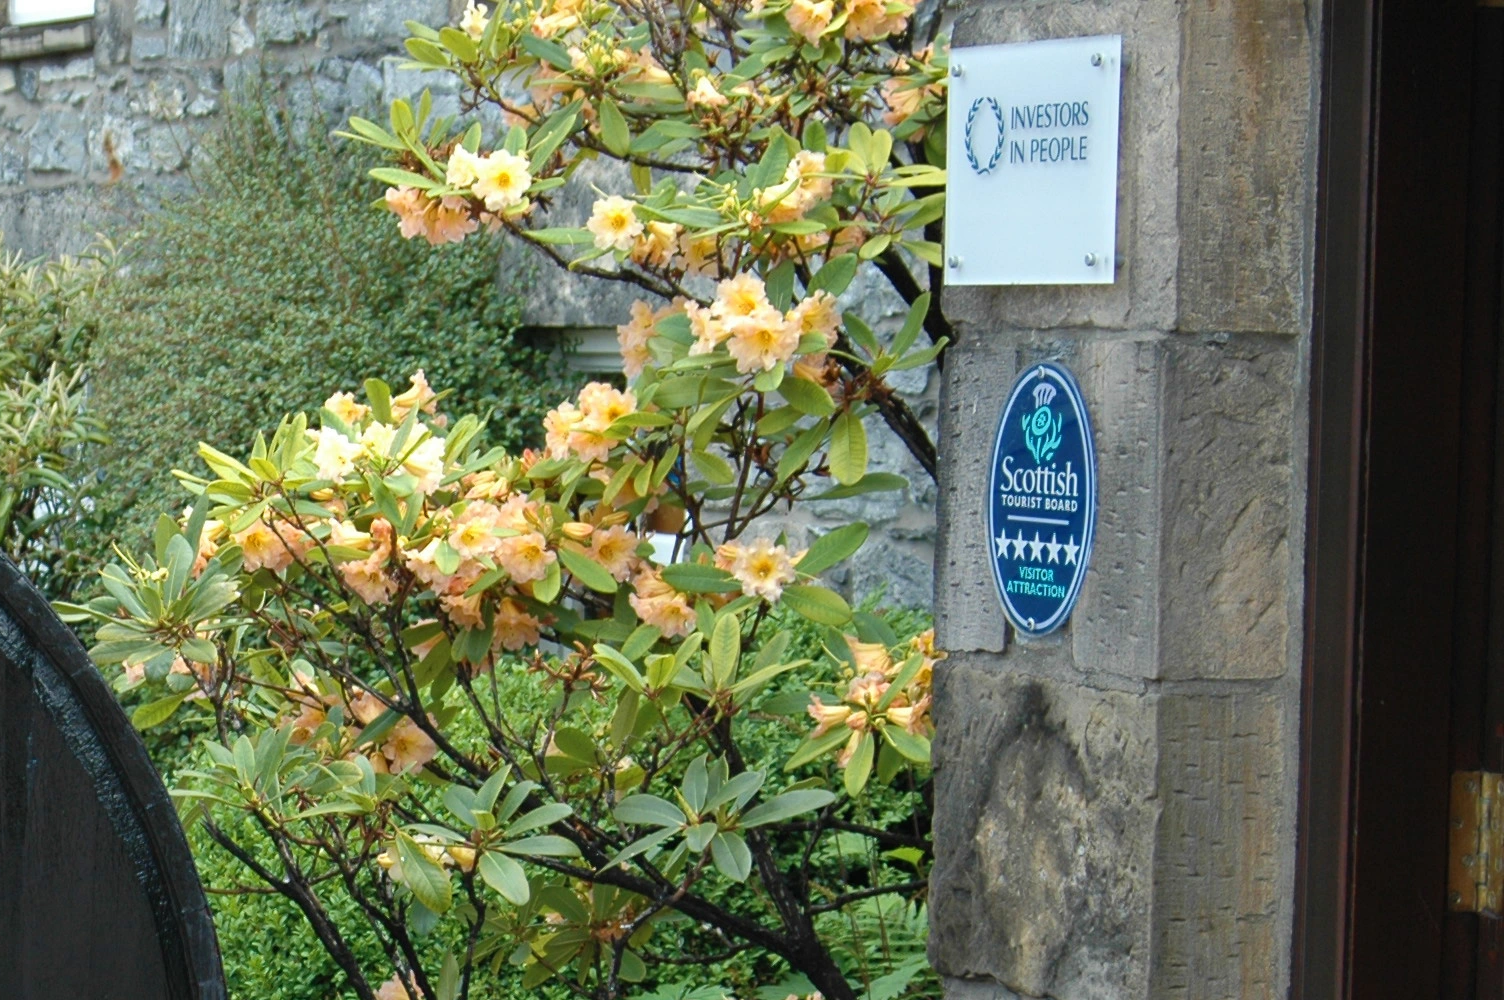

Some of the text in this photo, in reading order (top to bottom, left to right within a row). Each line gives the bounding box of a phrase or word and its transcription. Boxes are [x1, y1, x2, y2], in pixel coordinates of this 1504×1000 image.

[1010, 101, 1089, 129] INVESTORS
[1009, 135, 1088, 164] IN PEOPLE
[1000, 456, 1079, 496] Scottish
[1001, 494, 1079, 513] TOURIST BOARD
[1019, 566, 1054, 581] VISITOR
[1006, 580, 1066, 598] ATTRACTION
